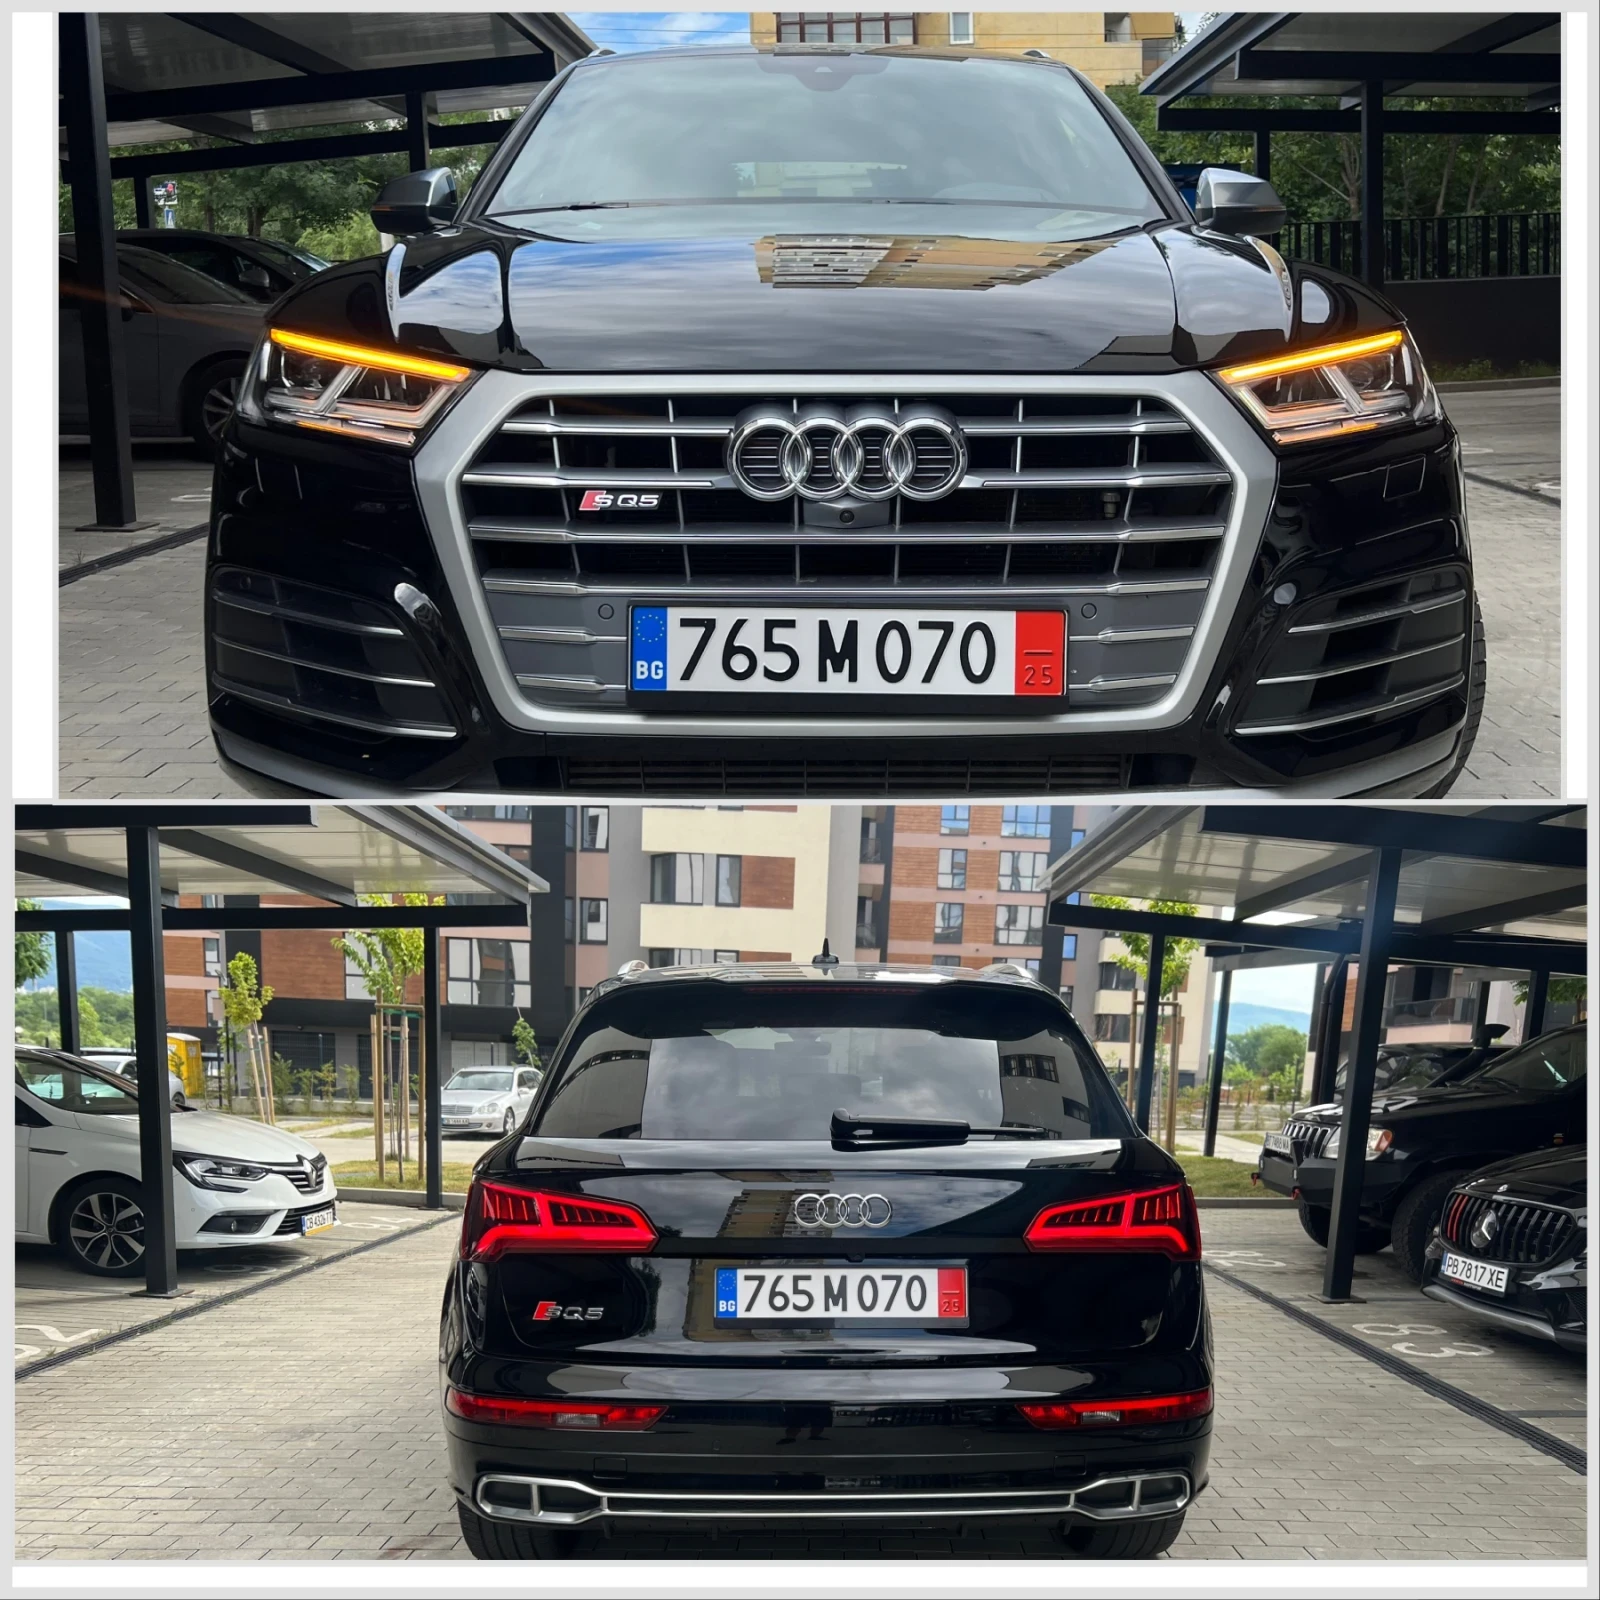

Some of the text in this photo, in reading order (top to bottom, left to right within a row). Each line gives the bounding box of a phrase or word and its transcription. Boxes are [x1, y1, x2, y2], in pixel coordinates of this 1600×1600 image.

[591, 493, 660, 508] SQ5
[680, 617, 996, 683] 765 M 070
[635, 660, 664, 680] BG
[1024, 664, 1054, 686] 25
[1446, 1256, 1459, 1275] PB
[1460, 1260, 1487, 1283] 7817
[1487, 1268, 1505, 1289] XE
[744, 1274, 927, 1312] 765 M 070
[719, 1300, 736, 1312] BG
[942, 1299, 961, 1312] 25
